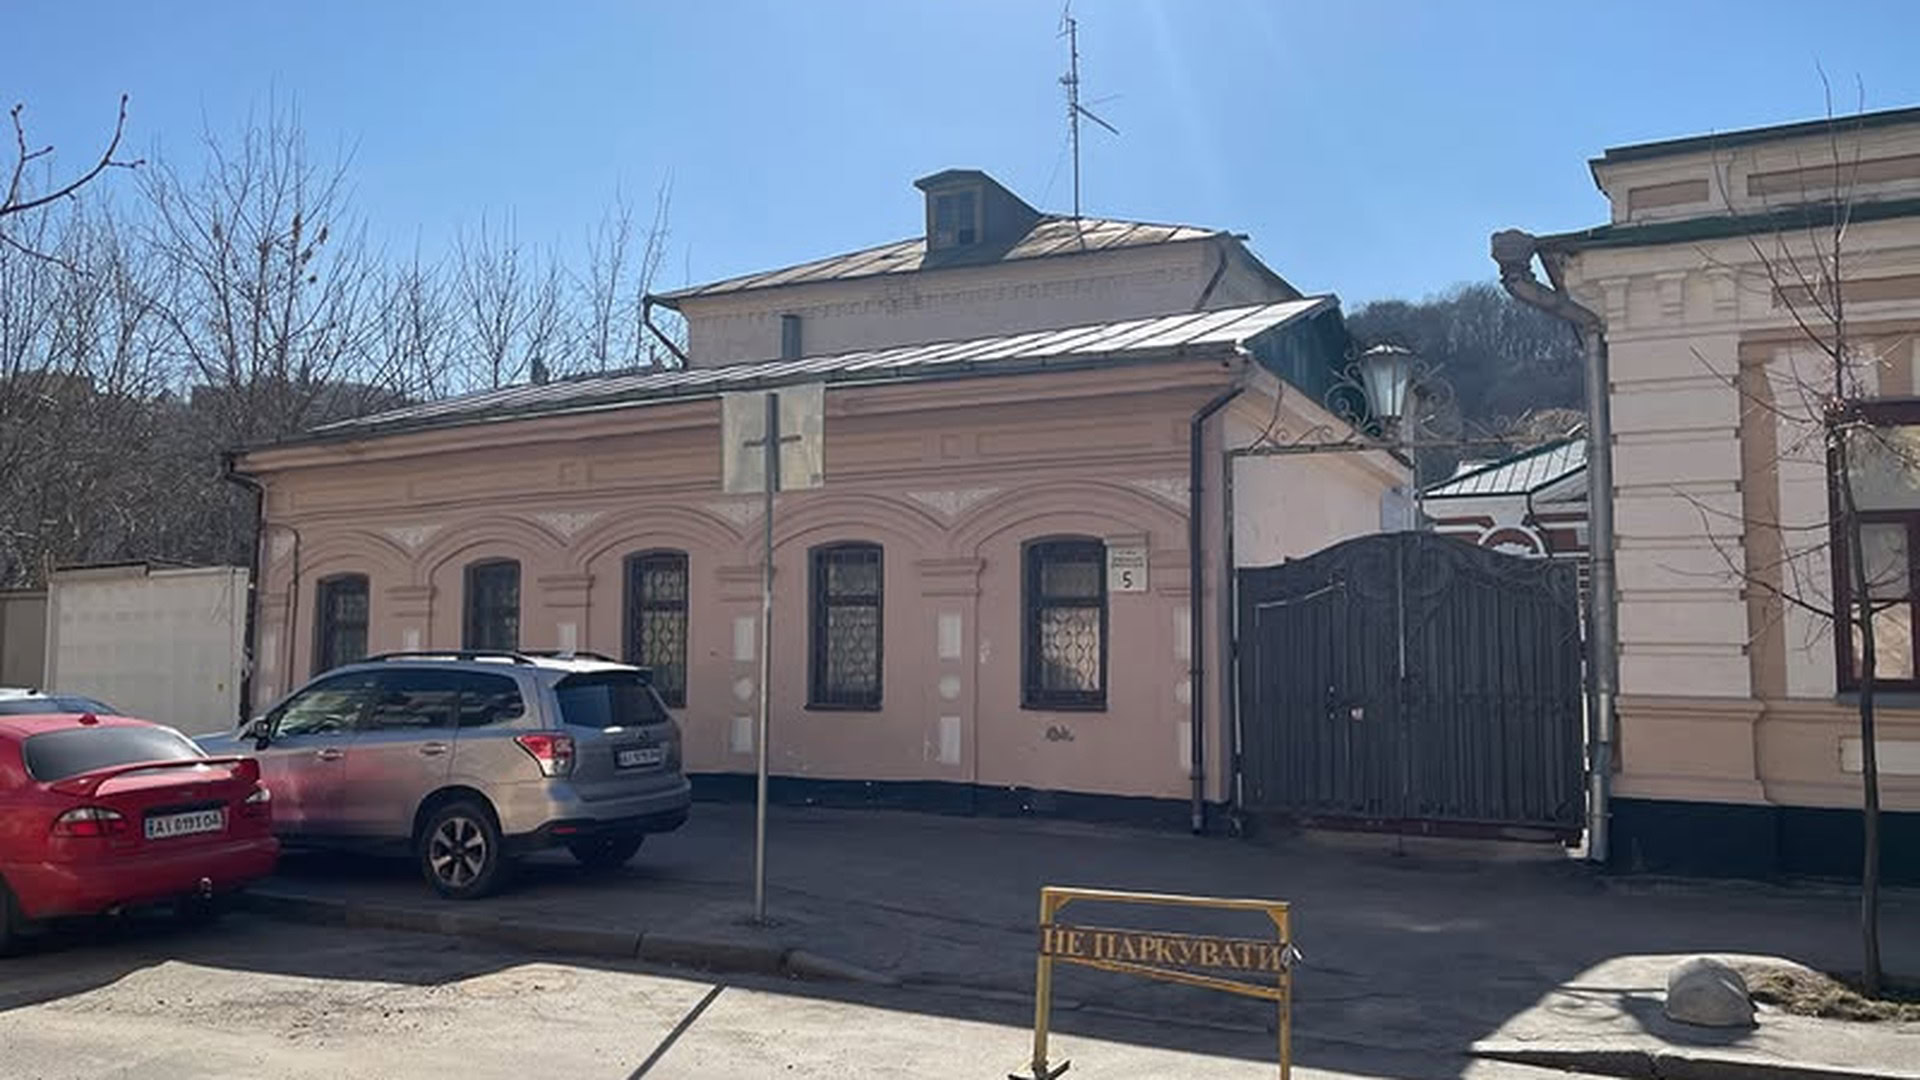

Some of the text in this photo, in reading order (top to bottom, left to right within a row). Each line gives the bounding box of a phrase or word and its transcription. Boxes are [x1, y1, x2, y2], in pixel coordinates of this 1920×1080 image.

[1122, 570, 1134, 589] 5
[1043, 927, 1282, 972] НЕ ПАРКУВАТИ
